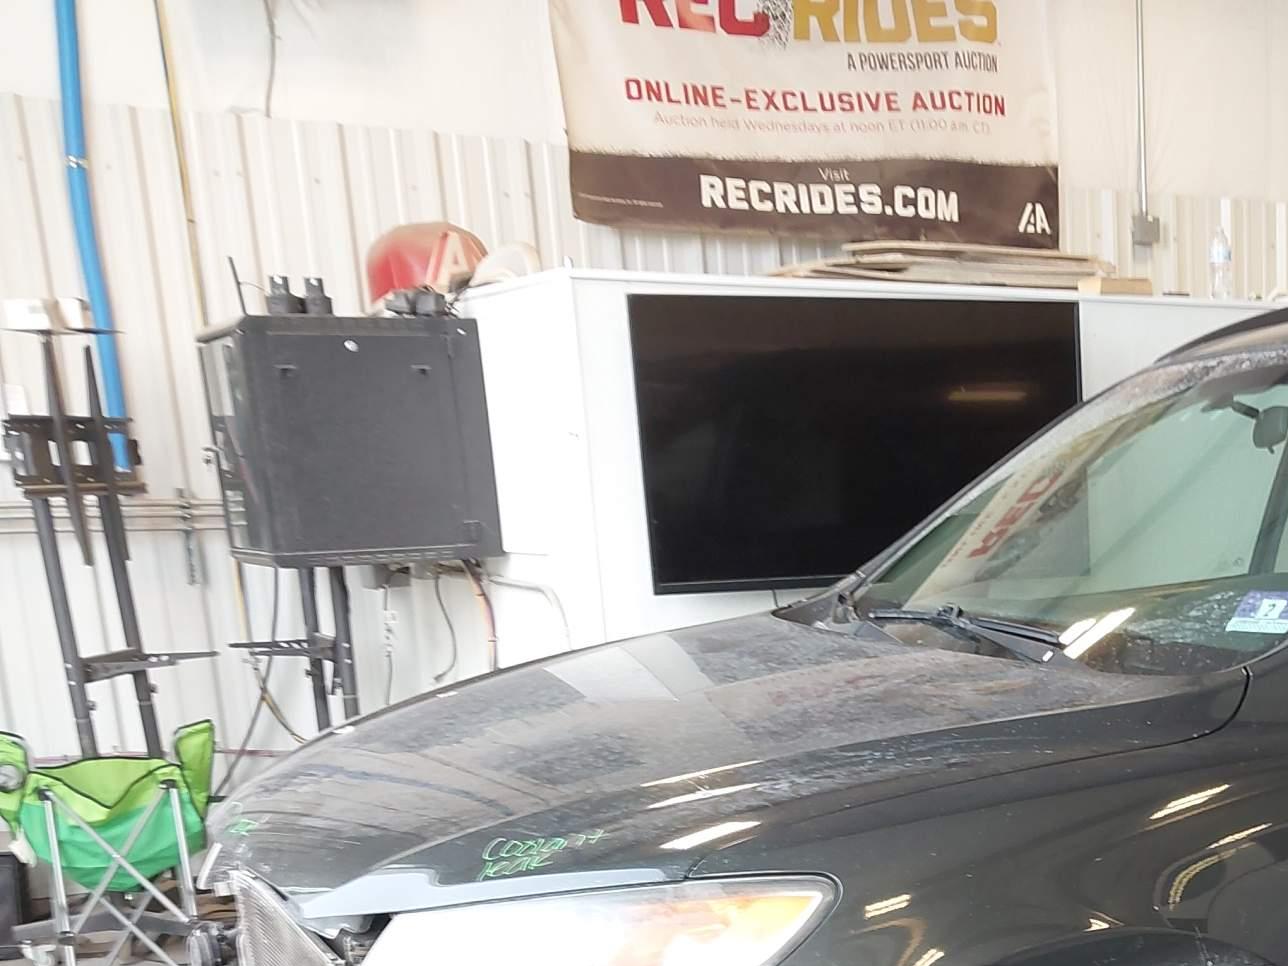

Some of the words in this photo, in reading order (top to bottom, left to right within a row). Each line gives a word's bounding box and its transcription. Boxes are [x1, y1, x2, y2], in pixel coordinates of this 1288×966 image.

[793, 0, 998, 44] RIDES
[847, 53, 857, 72] A
[859, 51, 950, 72] POWERSPORT
[954, 50, 998, 73] AUCTION
[624, 78, 901, 113] ONLINE-EXCLUSIVE
[911, 90, 1006, 117] AUCTION
[654, 111, 708, 129] Auction
[711, 115, 740, 131] held
[743, 118, 831, 136] Wednesdays
[818, 167, 850, 182] Visit
[700, 174, 960, 223] RECRIDES.COM
